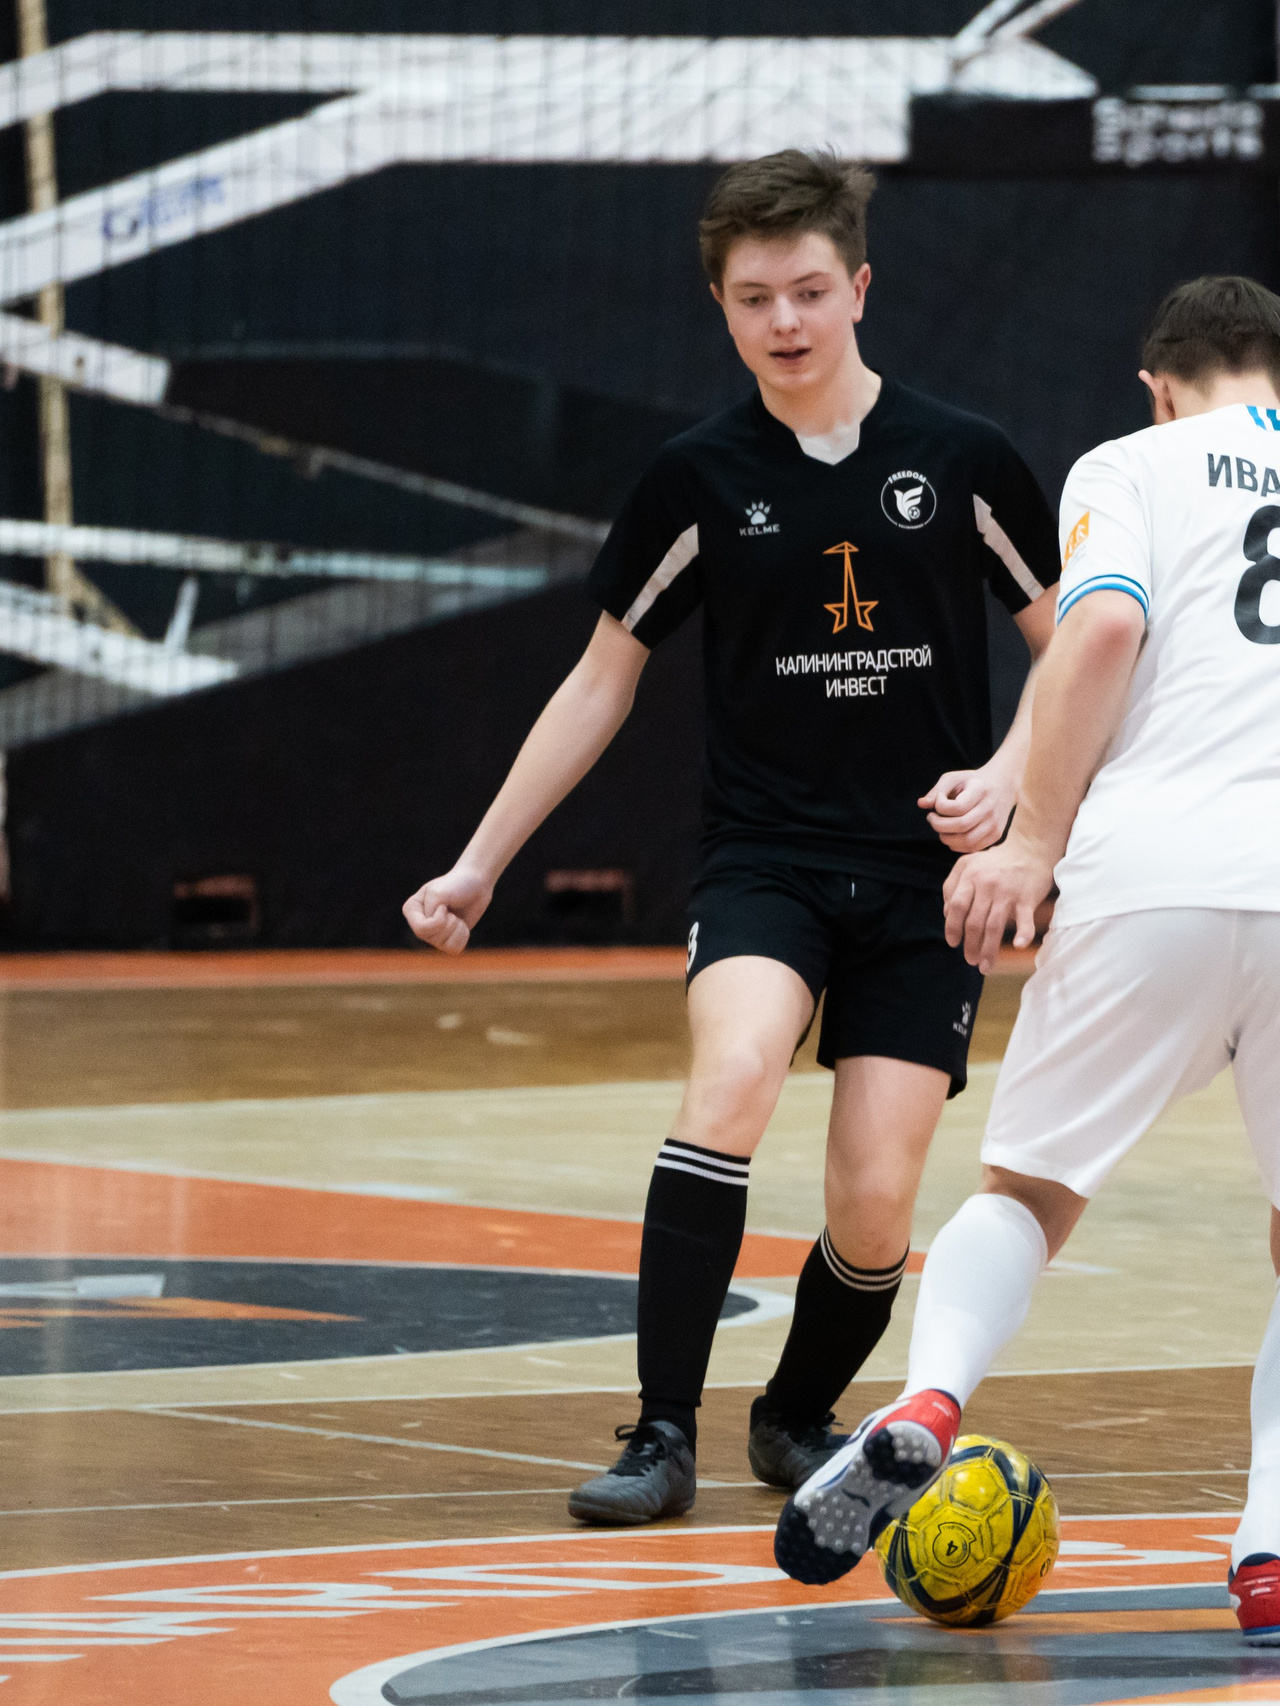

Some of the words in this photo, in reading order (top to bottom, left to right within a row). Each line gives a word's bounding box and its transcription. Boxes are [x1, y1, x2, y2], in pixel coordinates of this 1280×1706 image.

[887, 470, 927, 484] FREEDOM
[739, 523, 780, 537] KELME
[775, 644, 932, 676] КАЛИНИНГРАДСТРОЙ
[825, 676, 888, 699] ИНВЕСТ
[945, 1540, 959, 1557] 4
